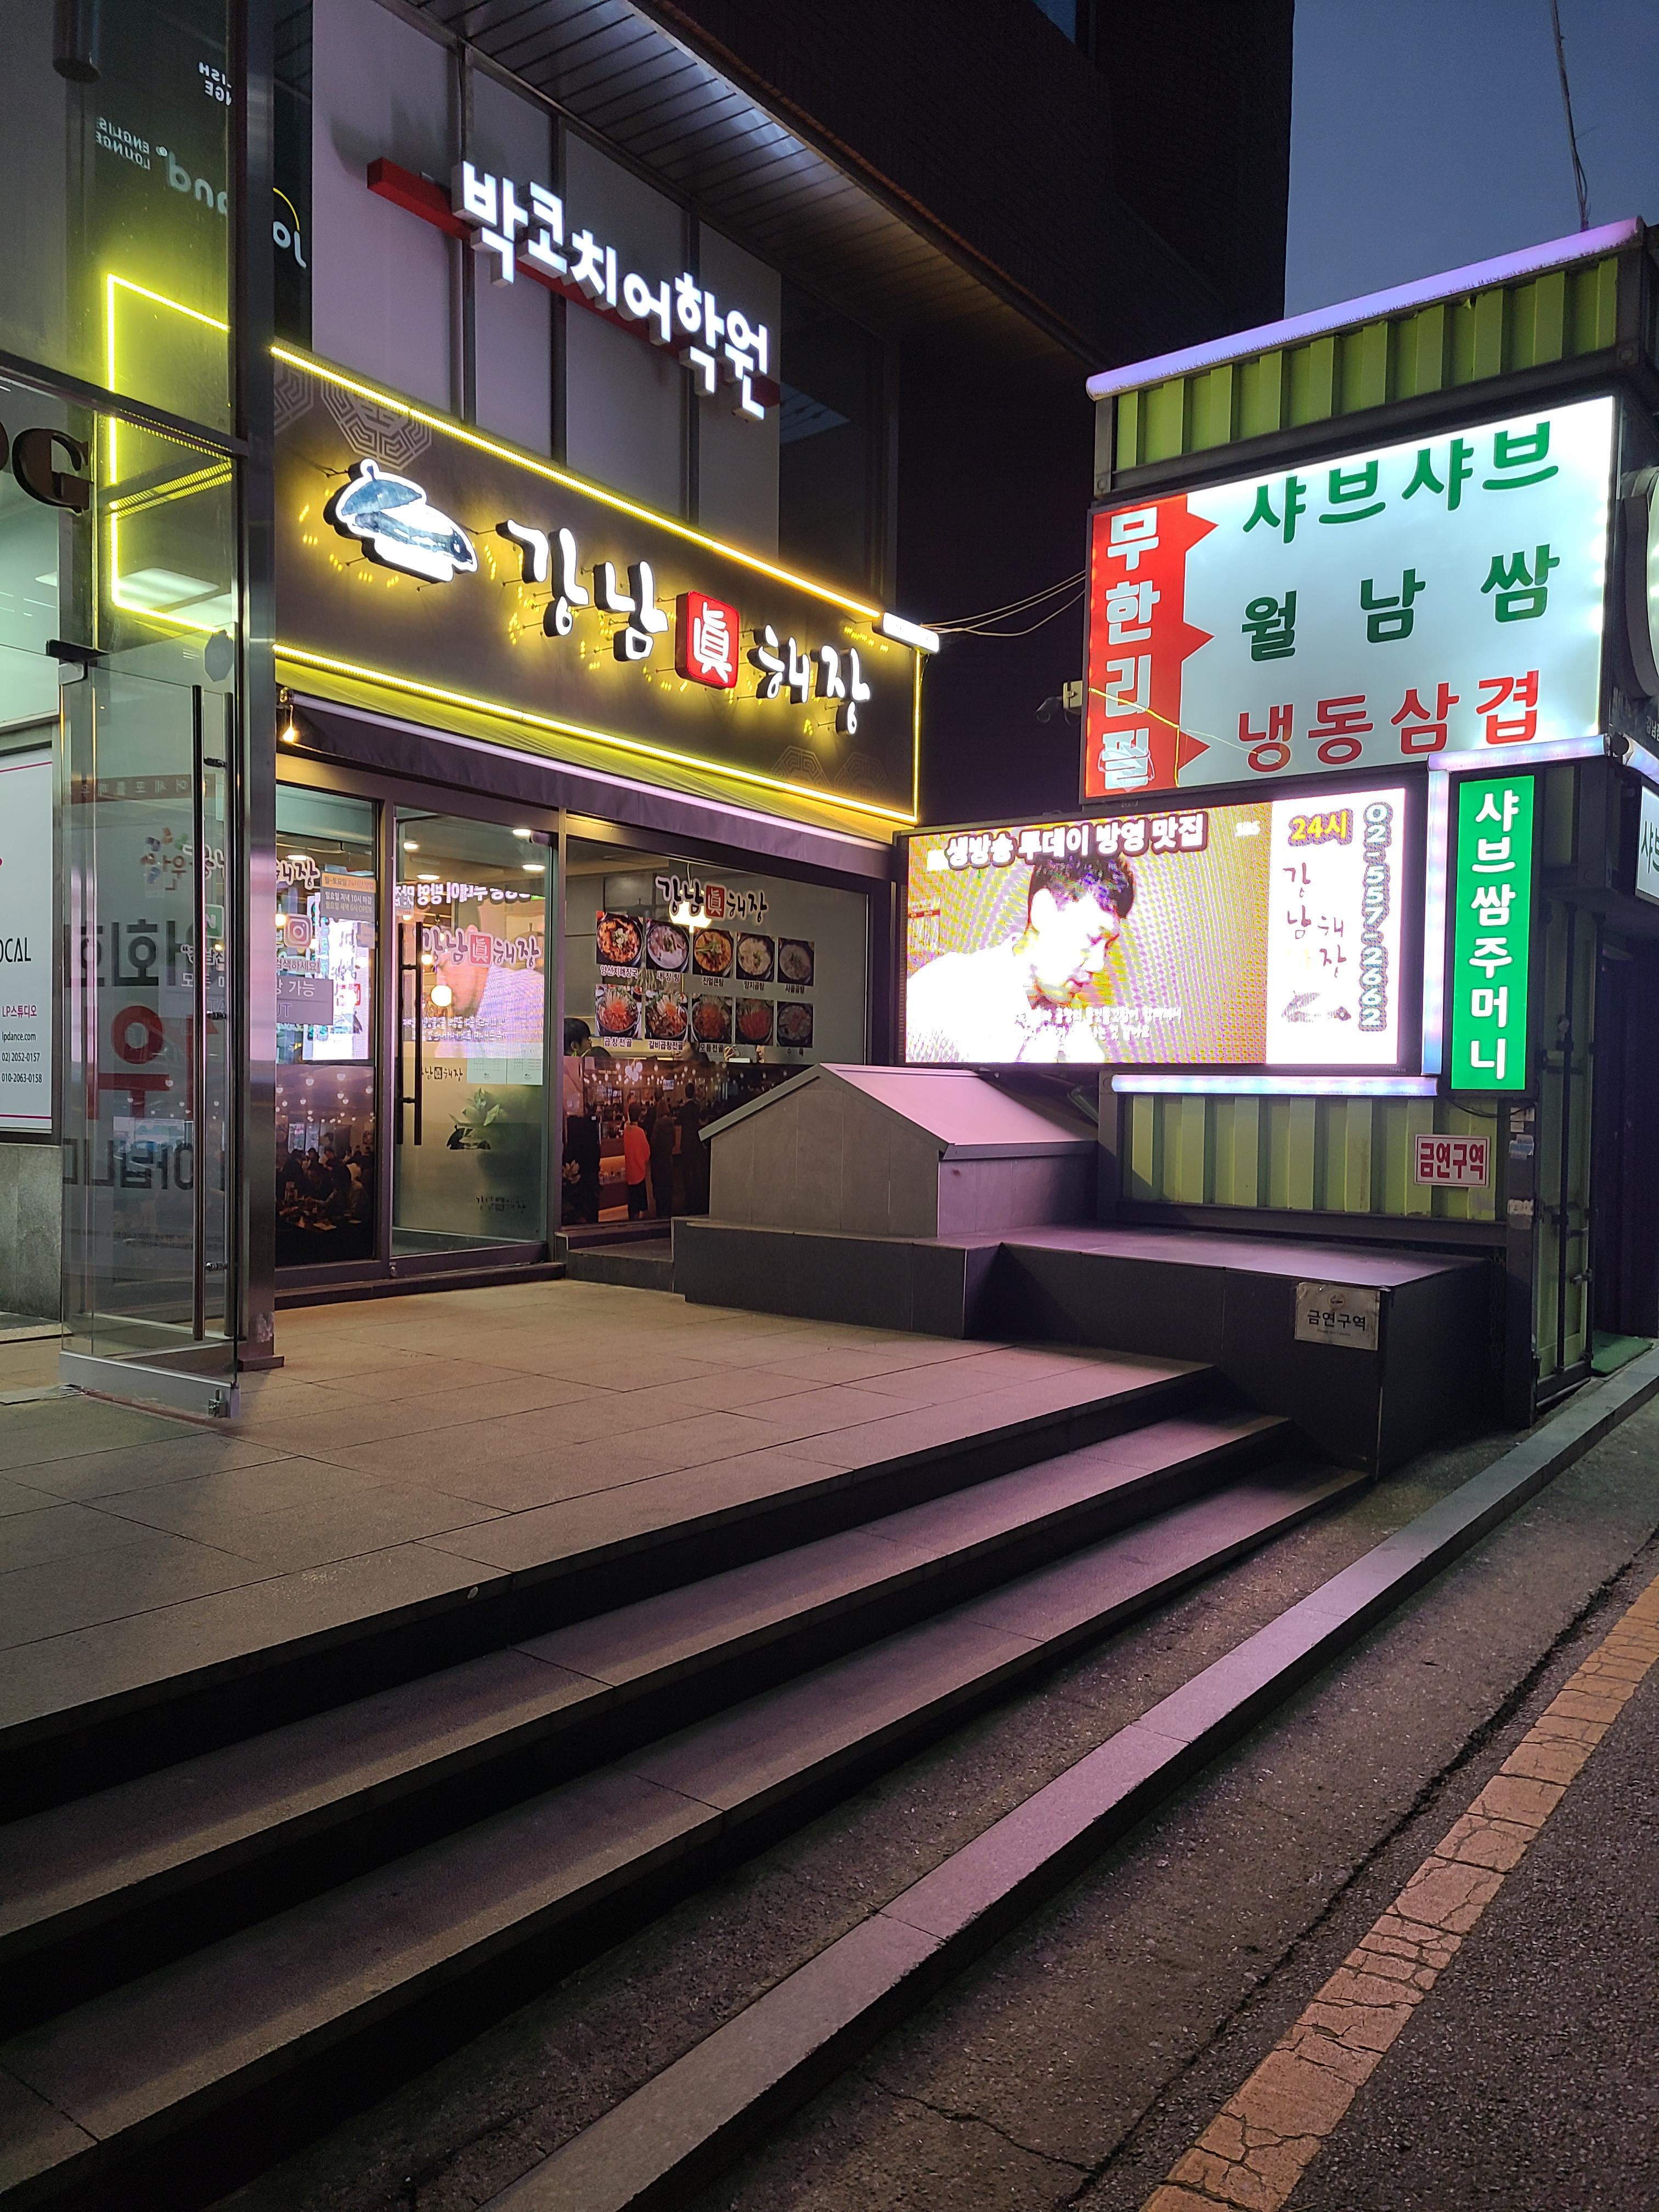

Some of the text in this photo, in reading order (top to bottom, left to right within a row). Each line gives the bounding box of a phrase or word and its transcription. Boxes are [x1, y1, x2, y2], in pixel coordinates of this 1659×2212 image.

[461, 160, 769, 421] 박코치어학원
[1242, 420, 1559, 544] 샤브샤브
[1241, 543, 1560, 663] 월남쌈
[1098, 507, 1161, 790] 무한리필
[1238, 669, 1541, 773] 냉동삼겹
[947, 835, 1013, 868] 생방송
[1018, 823, 1088, 861] 투데이
[1096, 820, 1146, 854] 방영
[1152, 812, 1206, 850] 맛집
[1289, 809, 1350, 845] 24시
[325, 891, 340, 901] 일요일
[351, 894, 362, 904] 10시
[1360, 802, 1392, 1031] 02-557-2662
[1468, 788, 1521, 1080] 샤브쌈주머니
[0, 937, 31, 963] CAL
[289, 980, 315, 997] 가능
[2, 1005, 37, 1018] LP스튜디오
[2, 1031, 36, 1042] lpdance.com
[604, 1037, 633, 1047] 곱창전골
[2, 1052, 40, 1063] 02) 2052-0157
[2, 1073, 42, 1084] 010-2063-0158
[1420, 1142, 1484, 1181] 금연구역
[1307, 1309, 1365, 1331] 금연구역
